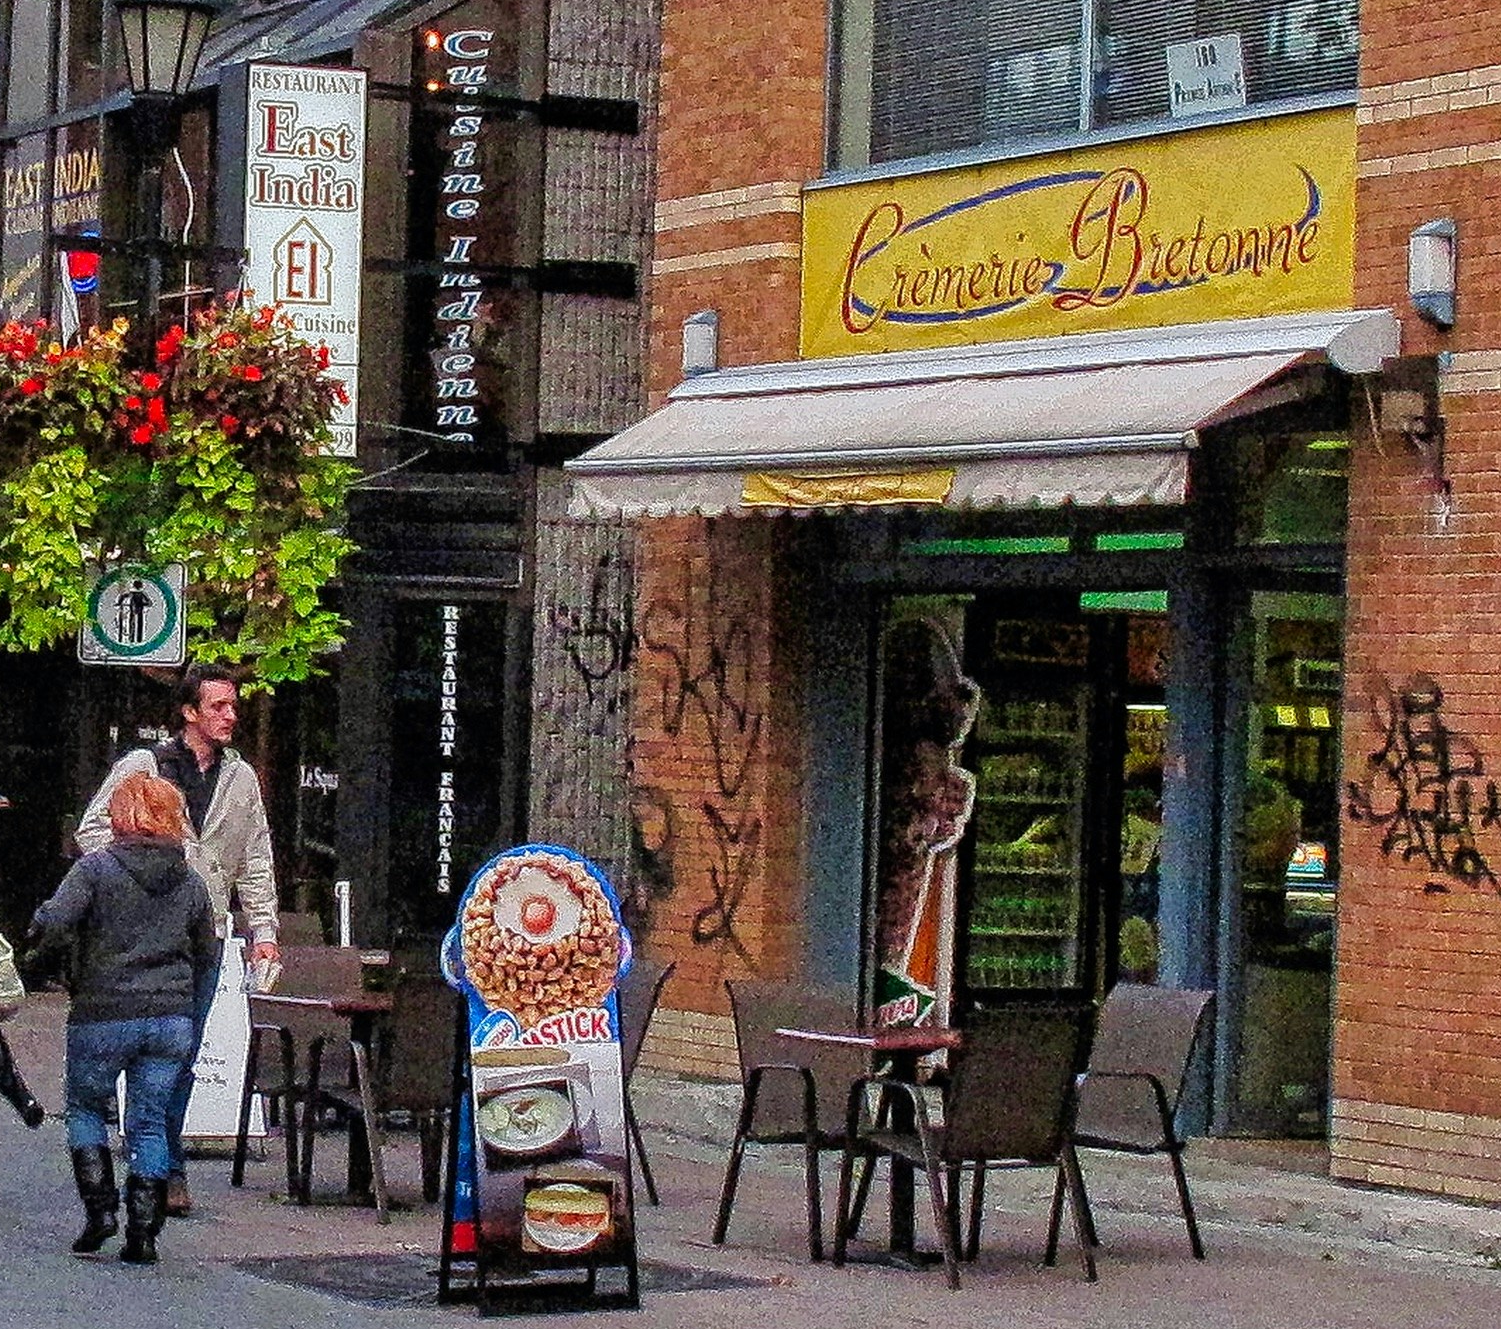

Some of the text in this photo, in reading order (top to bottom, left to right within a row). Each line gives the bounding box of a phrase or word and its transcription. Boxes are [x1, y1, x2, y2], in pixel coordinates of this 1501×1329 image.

[251, 70, 363, 95] RESTAURANT
[259, 101, 355, 161] East
[442, 29, 495, 220] Cuisine
[53, 147, 100, 199] INDIA
[251, 165, 356, 212] India
[1051, 167, 1320, 311] Bretonne
[287, 240, 319, 299] EI
[439, 605, 460, 757] RESTAURANT
